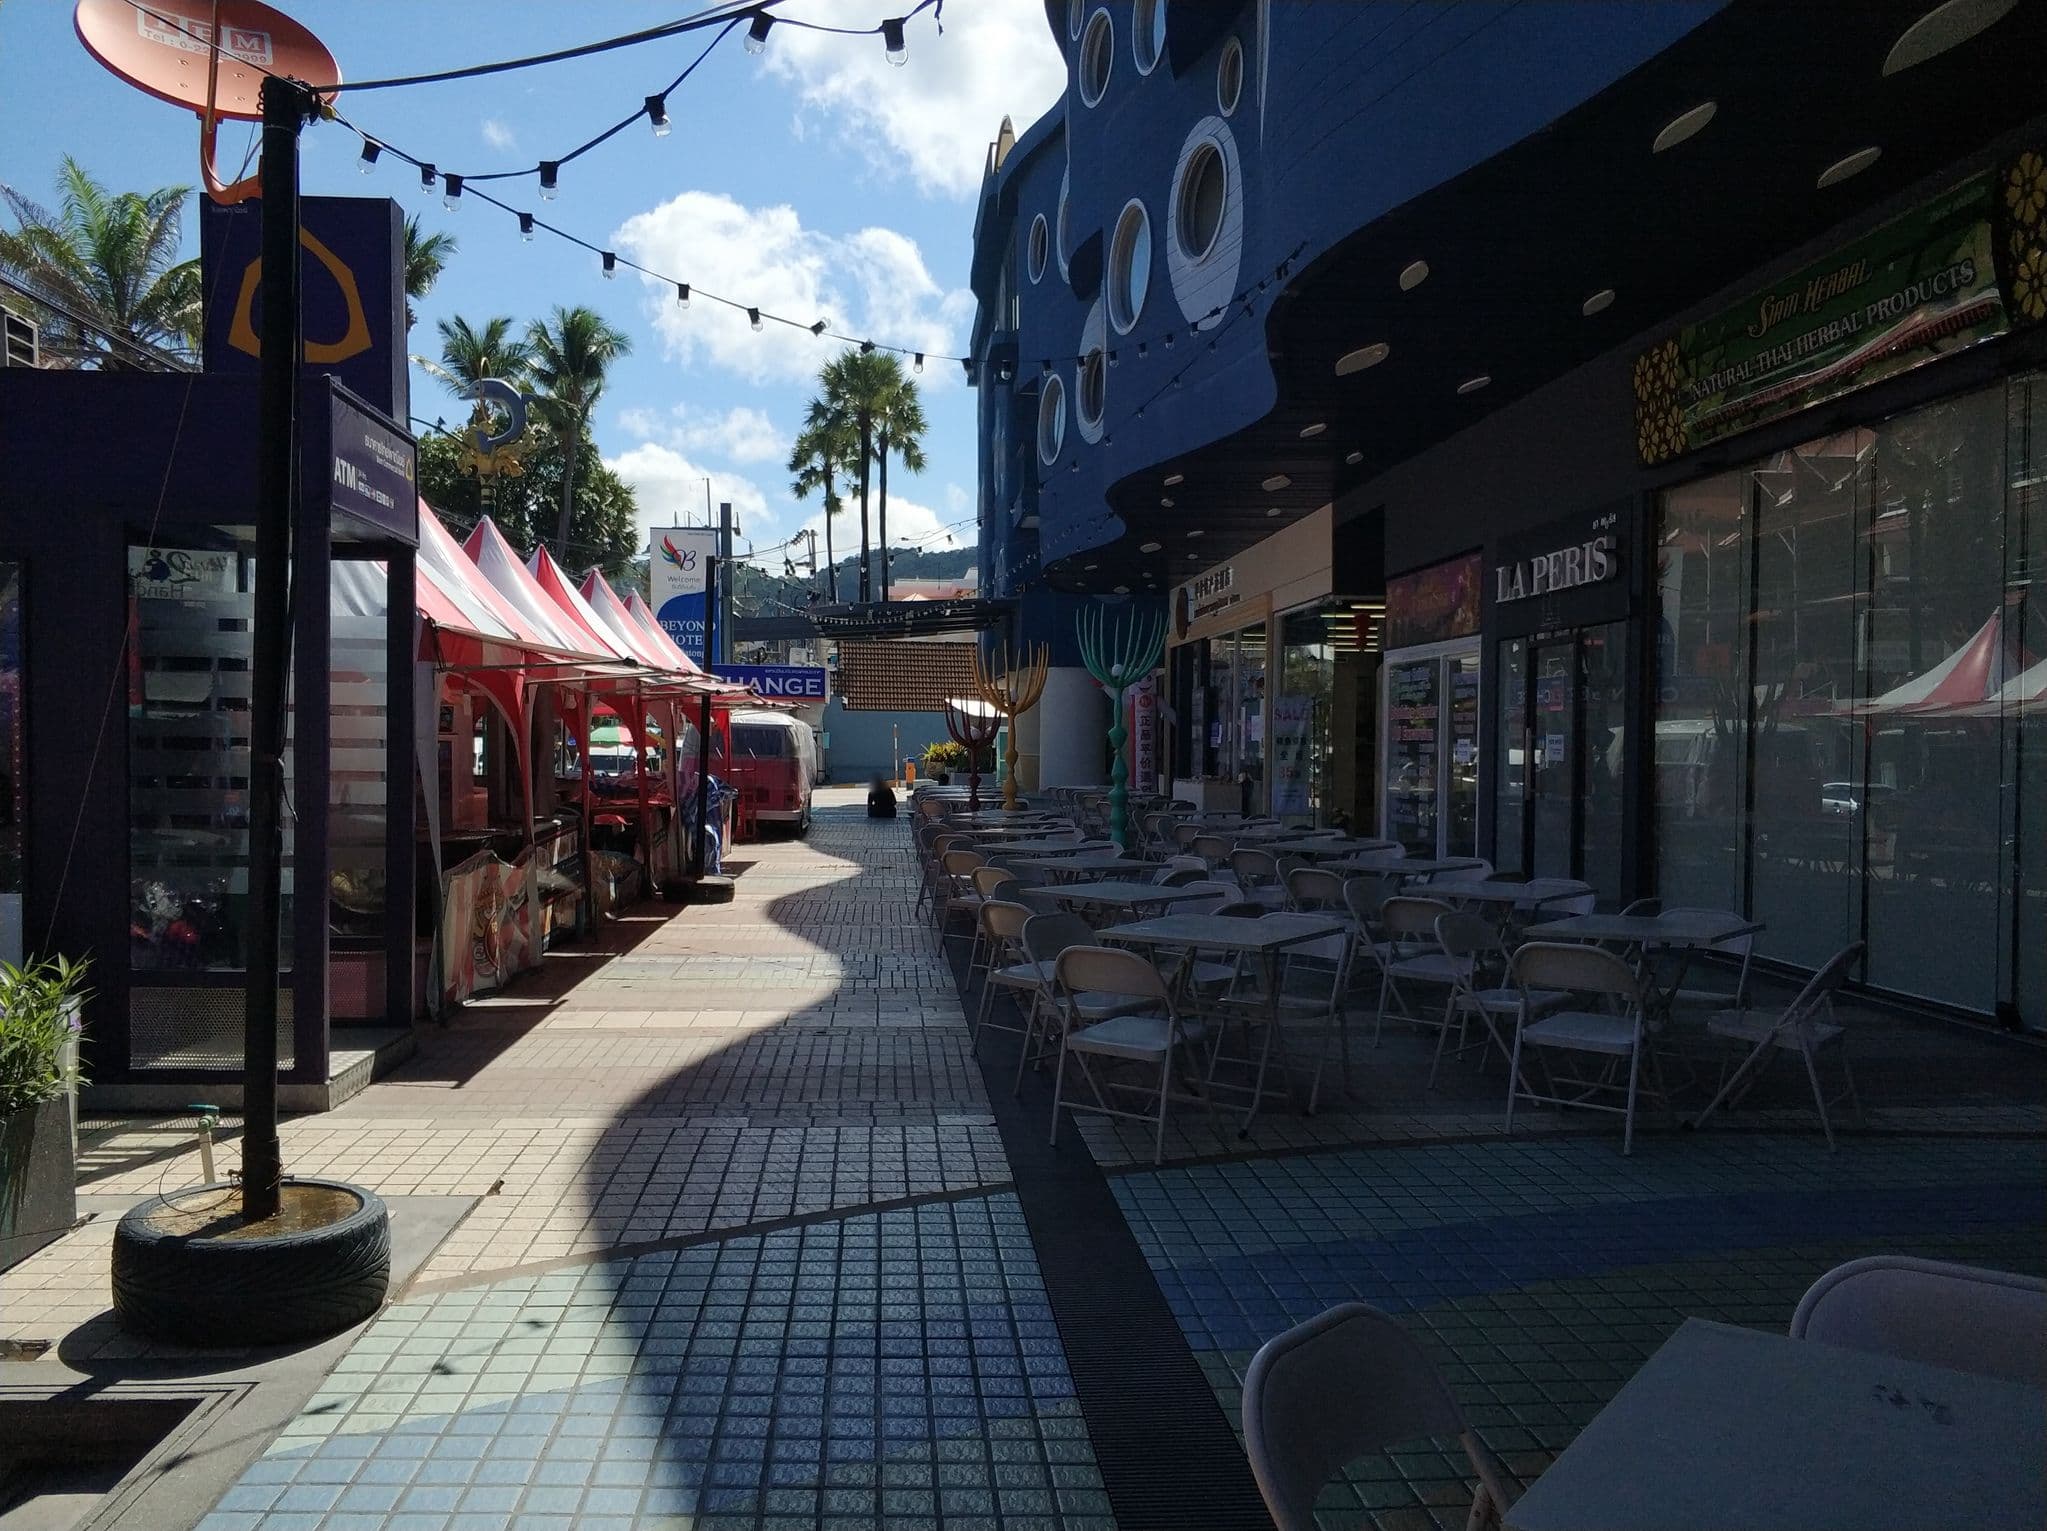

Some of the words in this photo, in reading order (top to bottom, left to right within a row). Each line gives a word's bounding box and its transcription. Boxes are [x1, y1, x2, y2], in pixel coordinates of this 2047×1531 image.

[1691, 361, 1754, 400] NATURAL
[1757, 340, 1793, 373] THAI
[1797, 312, 1862, 355] HERBAL
[1865, 259, 1975, 325] PRODUCTS
[334, 456, 356, 491] ATM
[667, 574, 701, 584] Welcome
[1496, 562, 1527, 603] LA
[1530, 536, 1612, 597] PERIS
[660, 620, 716, 631] BEYON
[672, 634, 703, 646] OTE
